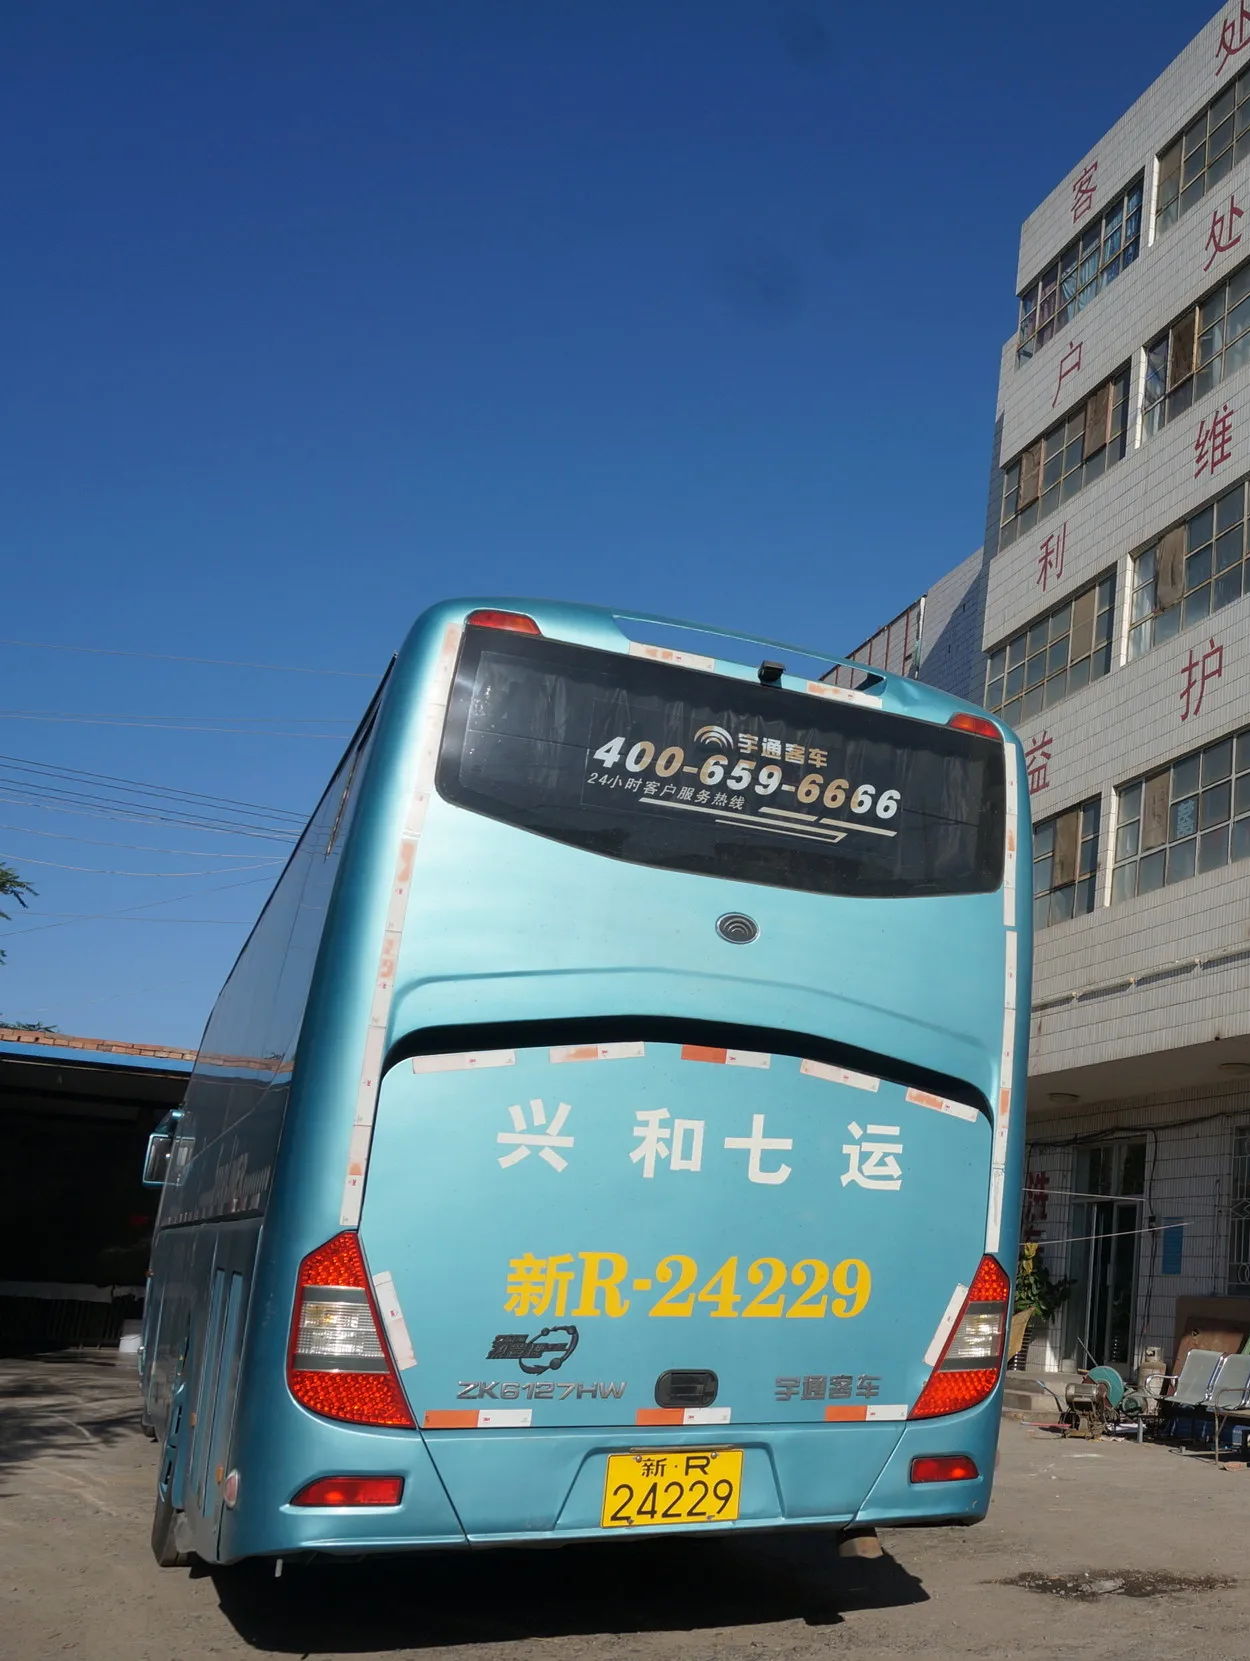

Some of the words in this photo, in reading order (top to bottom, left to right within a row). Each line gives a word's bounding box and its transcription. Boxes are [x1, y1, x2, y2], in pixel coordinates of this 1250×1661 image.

[737, 732, 829, 769] 宇通客车
[587, 772, 745, 811] 24小时客户服务热线
[593, 736, 901, 819] 400-659-6666
[497, 1098, 903, 1191] 兴和七运
[503, 1251, 872, 1319] 新R-24229
[457, 1380, 627, 1401] ZK6127HW
[775, 1374, 882, 1402] 宇通客车
[610, 1478, 734, 1522] 24229
